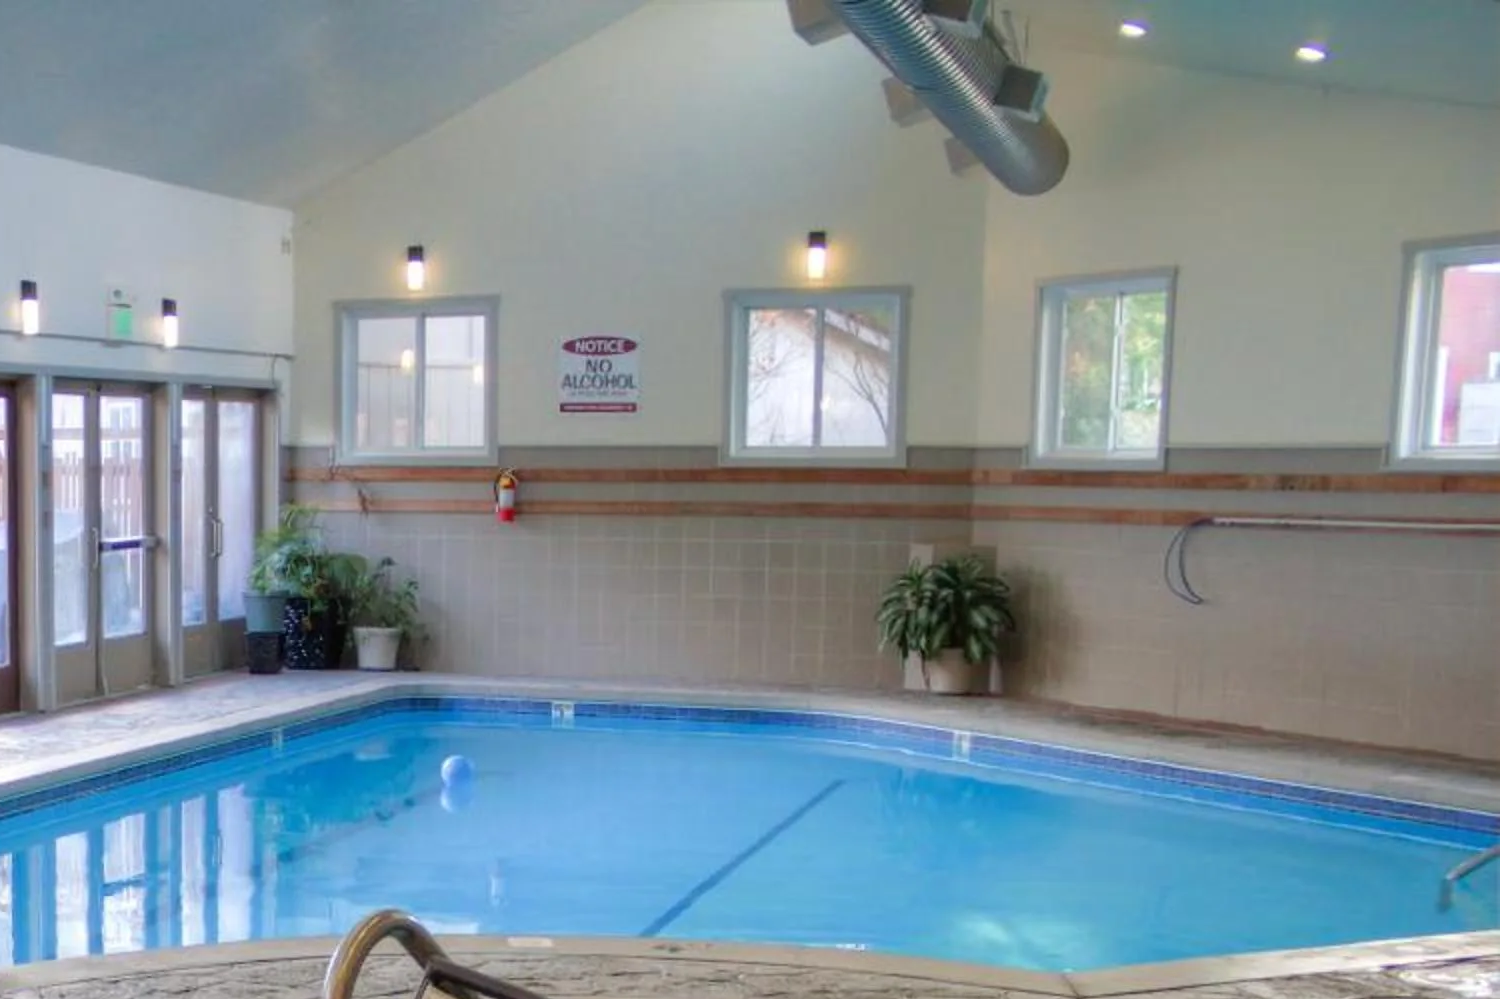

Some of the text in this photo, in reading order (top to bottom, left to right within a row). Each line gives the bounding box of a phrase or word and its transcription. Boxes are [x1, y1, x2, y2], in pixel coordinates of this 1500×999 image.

[575, 340, 623, 353] NOTICE
[585, 359, 613, 373] NO
[561, 374, 637, 389] ALCOHOL
